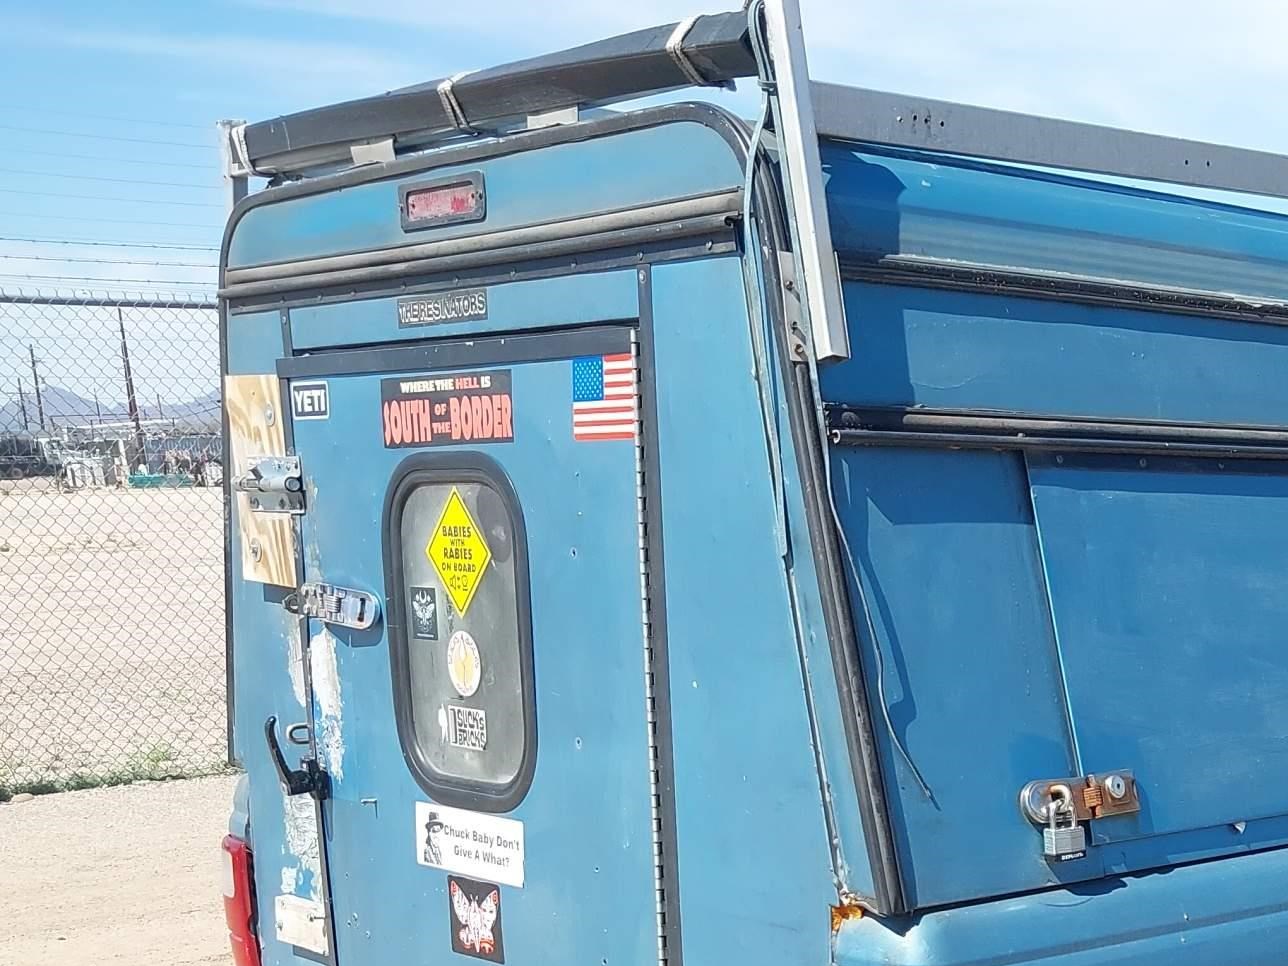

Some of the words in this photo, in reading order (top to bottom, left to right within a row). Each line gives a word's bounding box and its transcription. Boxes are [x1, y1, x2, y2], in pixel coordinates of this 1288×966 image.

[400, 380, 435, 394] WHERE
[434, 379, 454, 393] THE
[455, 377, 480, 390] HELL
[480, 375, 491, 388] IS
[294, 389, 326, 413] YETI
[434, 403, 447, 416] OF
[449, 394, 513, 441] BORDER
[383, 399, 432, 446] SOUTH
[432, 421, 452, 434] THE
[441, 525, 472, 538] BABIES
[449, 538, 466, 547] WITH
[443, 547, 473, 560] RABIES
[441, 562, 452, 571] ON
[453, 563, 476, 573] BOARD
[443, 824, 470, 840] Chuck
[472, 830, 495, 849] Baby
[496, 835, 520, 851] Don't
[453, 845, 473, 859] Give
[474, 849, 480, 860] A
[482, 850, 510, 868] What?
